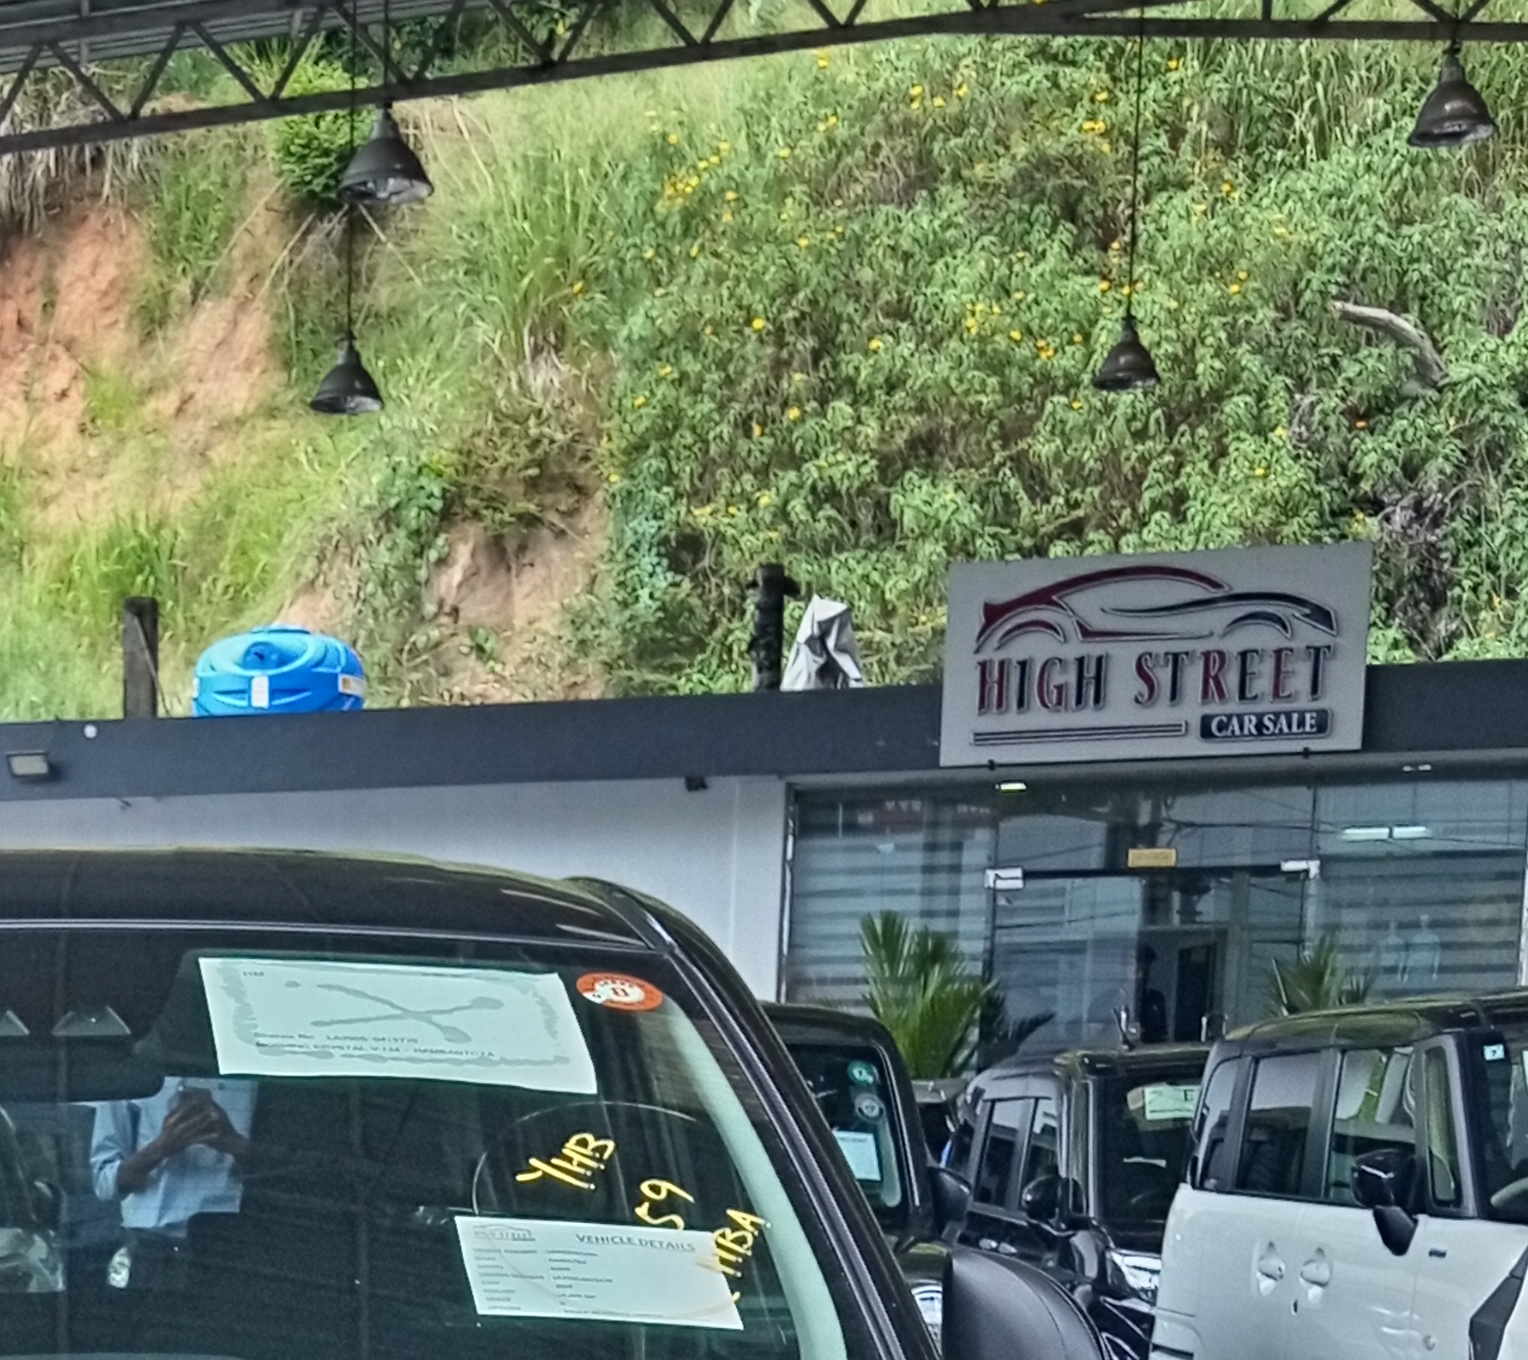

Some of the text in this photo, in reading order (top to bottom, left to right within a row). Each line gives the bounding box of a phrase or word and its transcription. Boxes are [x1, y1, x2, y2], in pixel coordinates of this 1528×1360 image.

[975, 644, 1334, 715] HIGH STREET
[1210, 712, 1318, 738] CAR SALE
[575, 1232, 696, 1252] VEHICLE DETAILS
